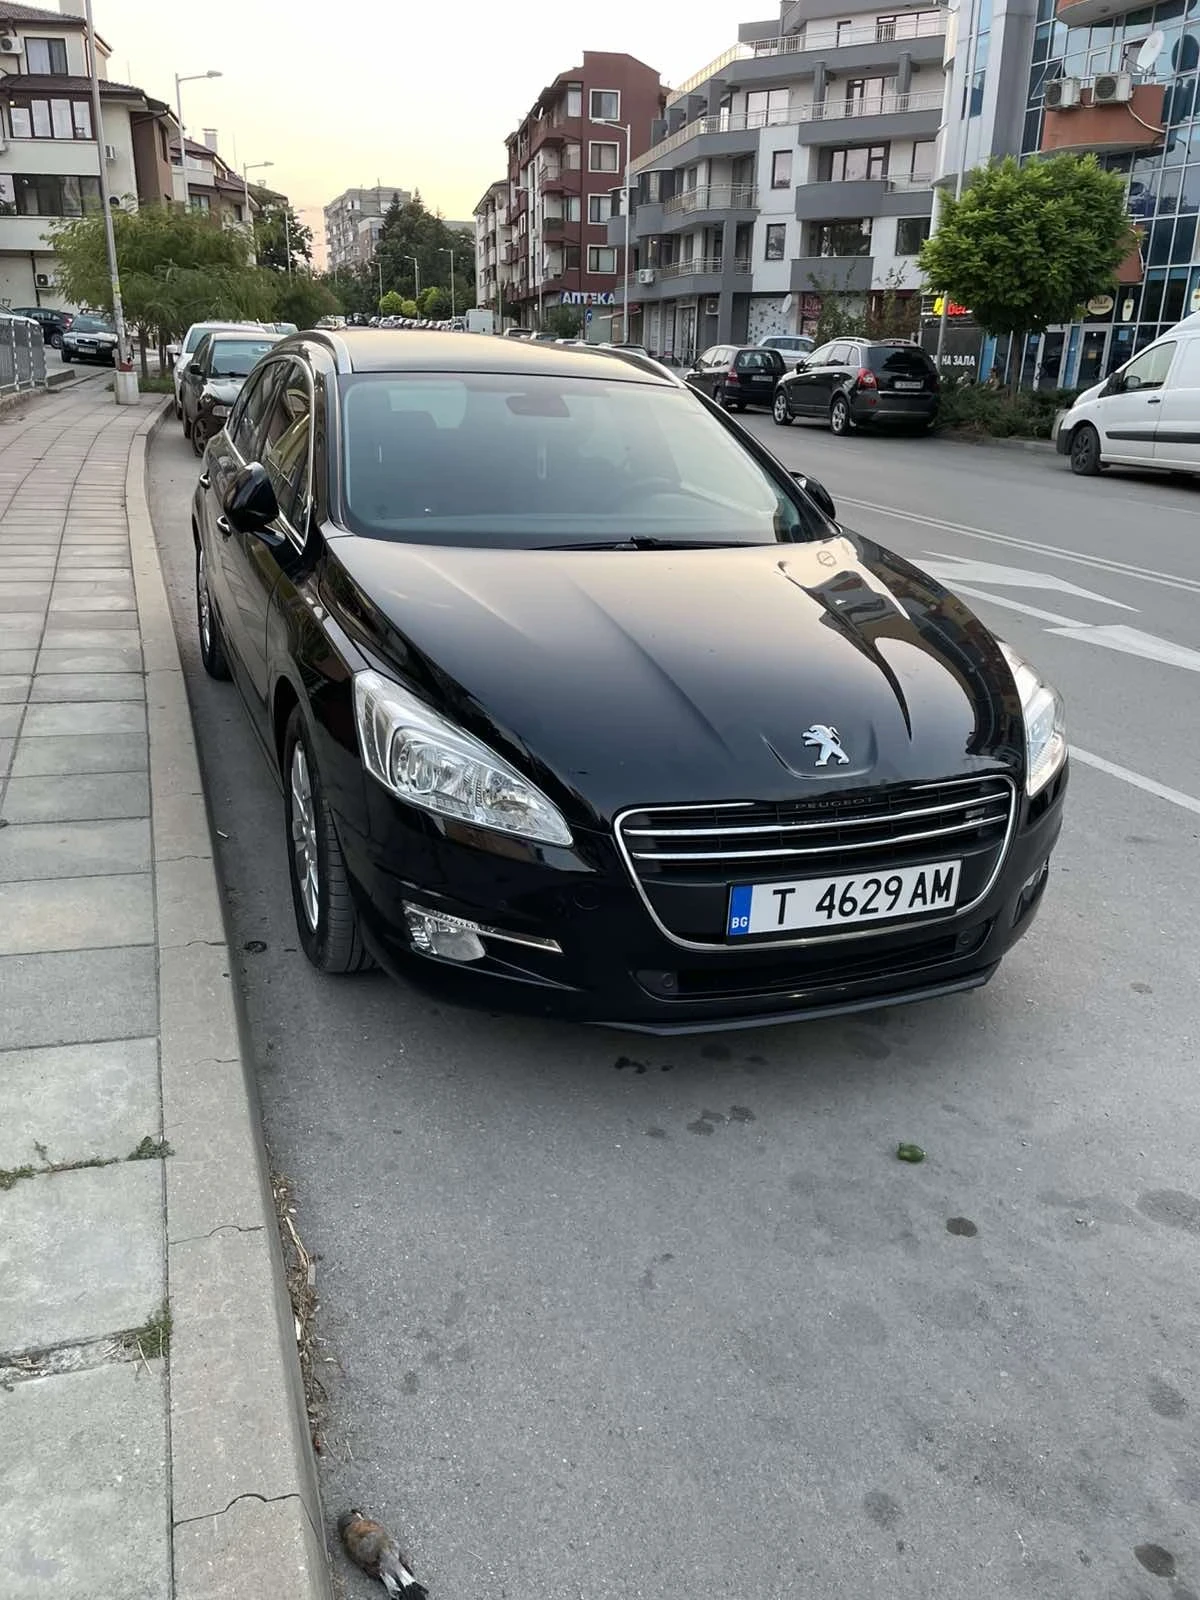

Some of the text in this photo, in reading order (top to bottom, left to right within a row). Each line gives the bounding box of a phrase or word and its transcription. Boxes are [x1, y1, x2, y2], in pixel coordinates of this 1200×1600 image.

[562, 291, 616, 305] АПТЕКА
[953, 355, 976, 367] ЗАЛА
[794, 796, 872, 809] PEUGEOT
[772, 867, 954, 925] T 4629 AM
[731, 917, 748, 929] BG
